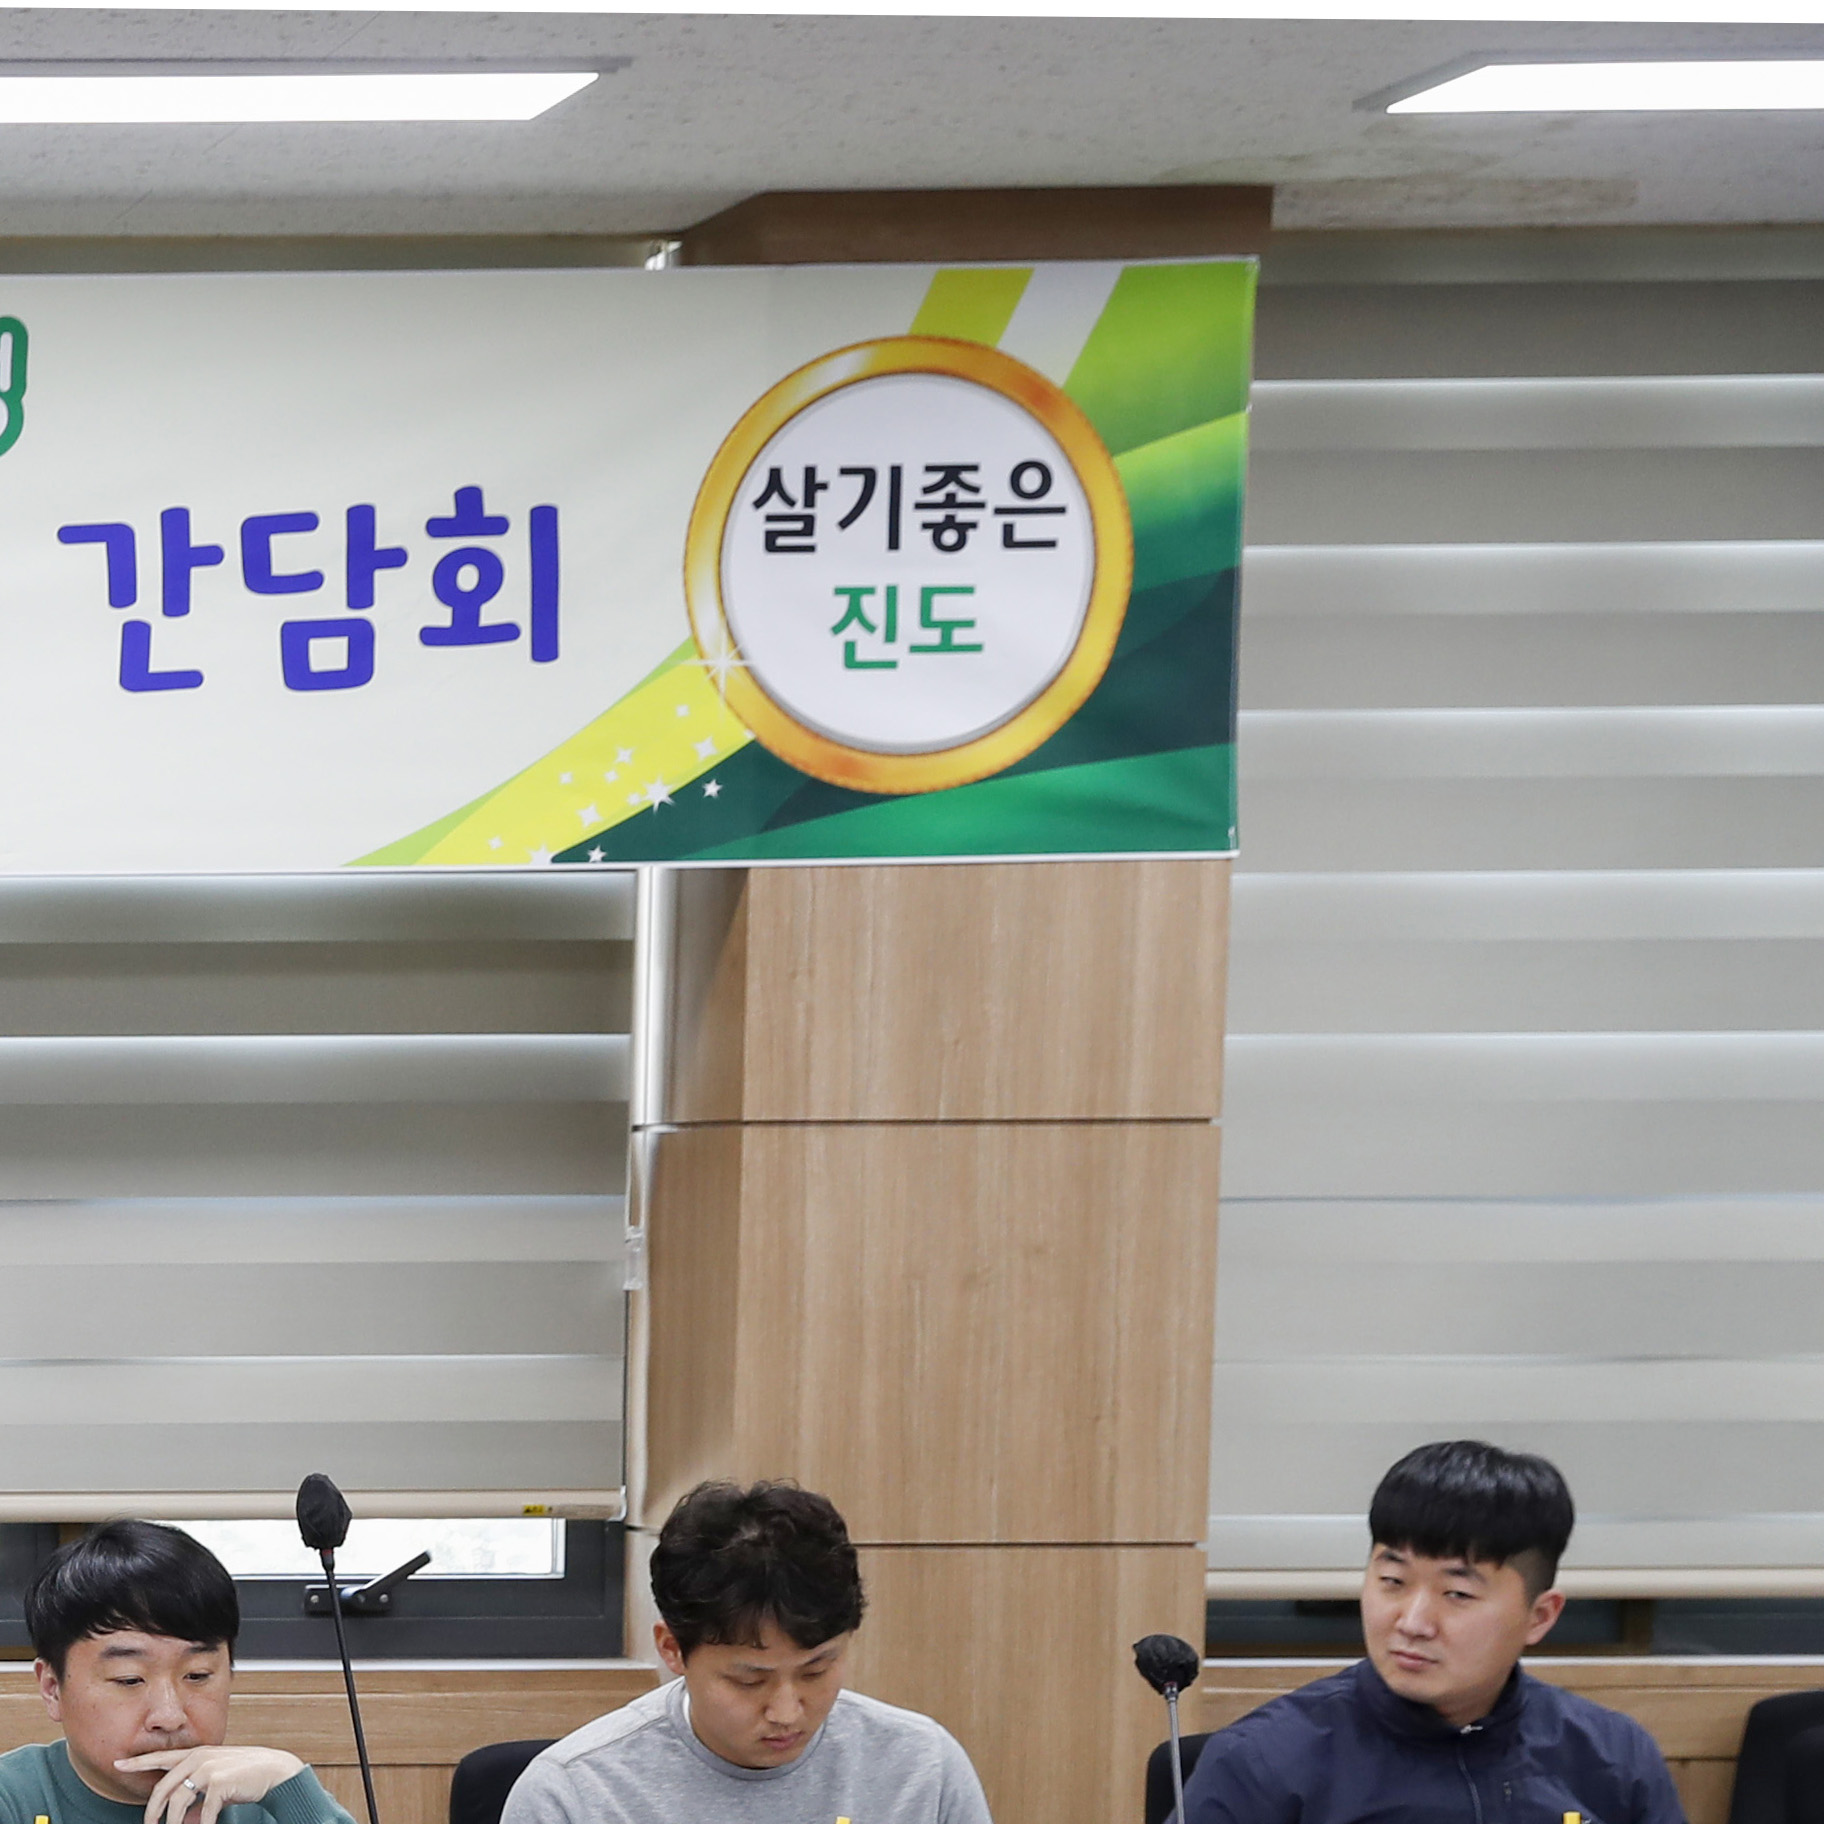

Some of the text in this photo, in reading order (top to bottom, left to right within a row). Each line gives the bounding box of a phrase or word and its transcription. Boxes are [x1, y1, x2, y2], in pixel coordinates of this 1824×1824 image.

[751, 459, 1067, 554] 살기좋은
[56, 484, 564, 696] 간담회
[831, 584, 985, 671] 진도
